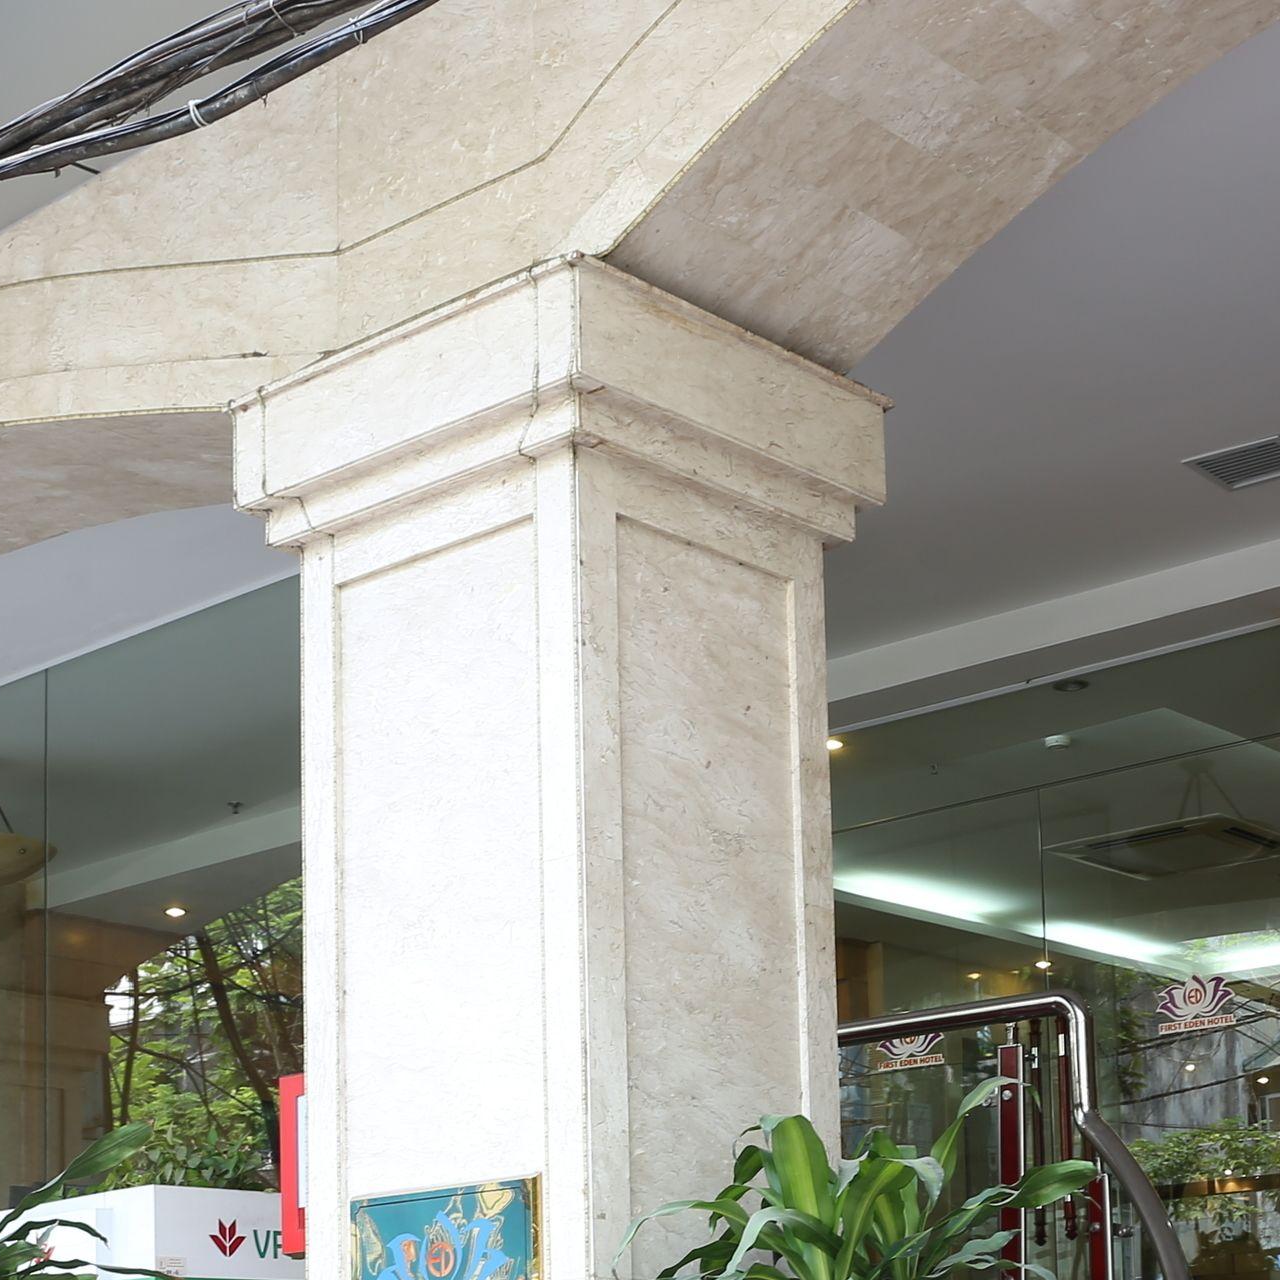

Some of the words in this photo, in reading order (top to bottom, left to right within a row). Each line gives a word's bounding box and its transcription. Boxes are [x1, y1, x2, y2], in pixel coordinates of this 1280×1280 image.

[1160, 1023, 1181, 1033] FIRST
[1184, 1019, 1206, 1029] EDEN
[1207, 1015, 1233, 1026] HOTEL
[879, 1060, 898, 1070] FIRST
[899, 1058, 919, 1067] EDEN
[920, 1055, 943, 1065] HOTEL
